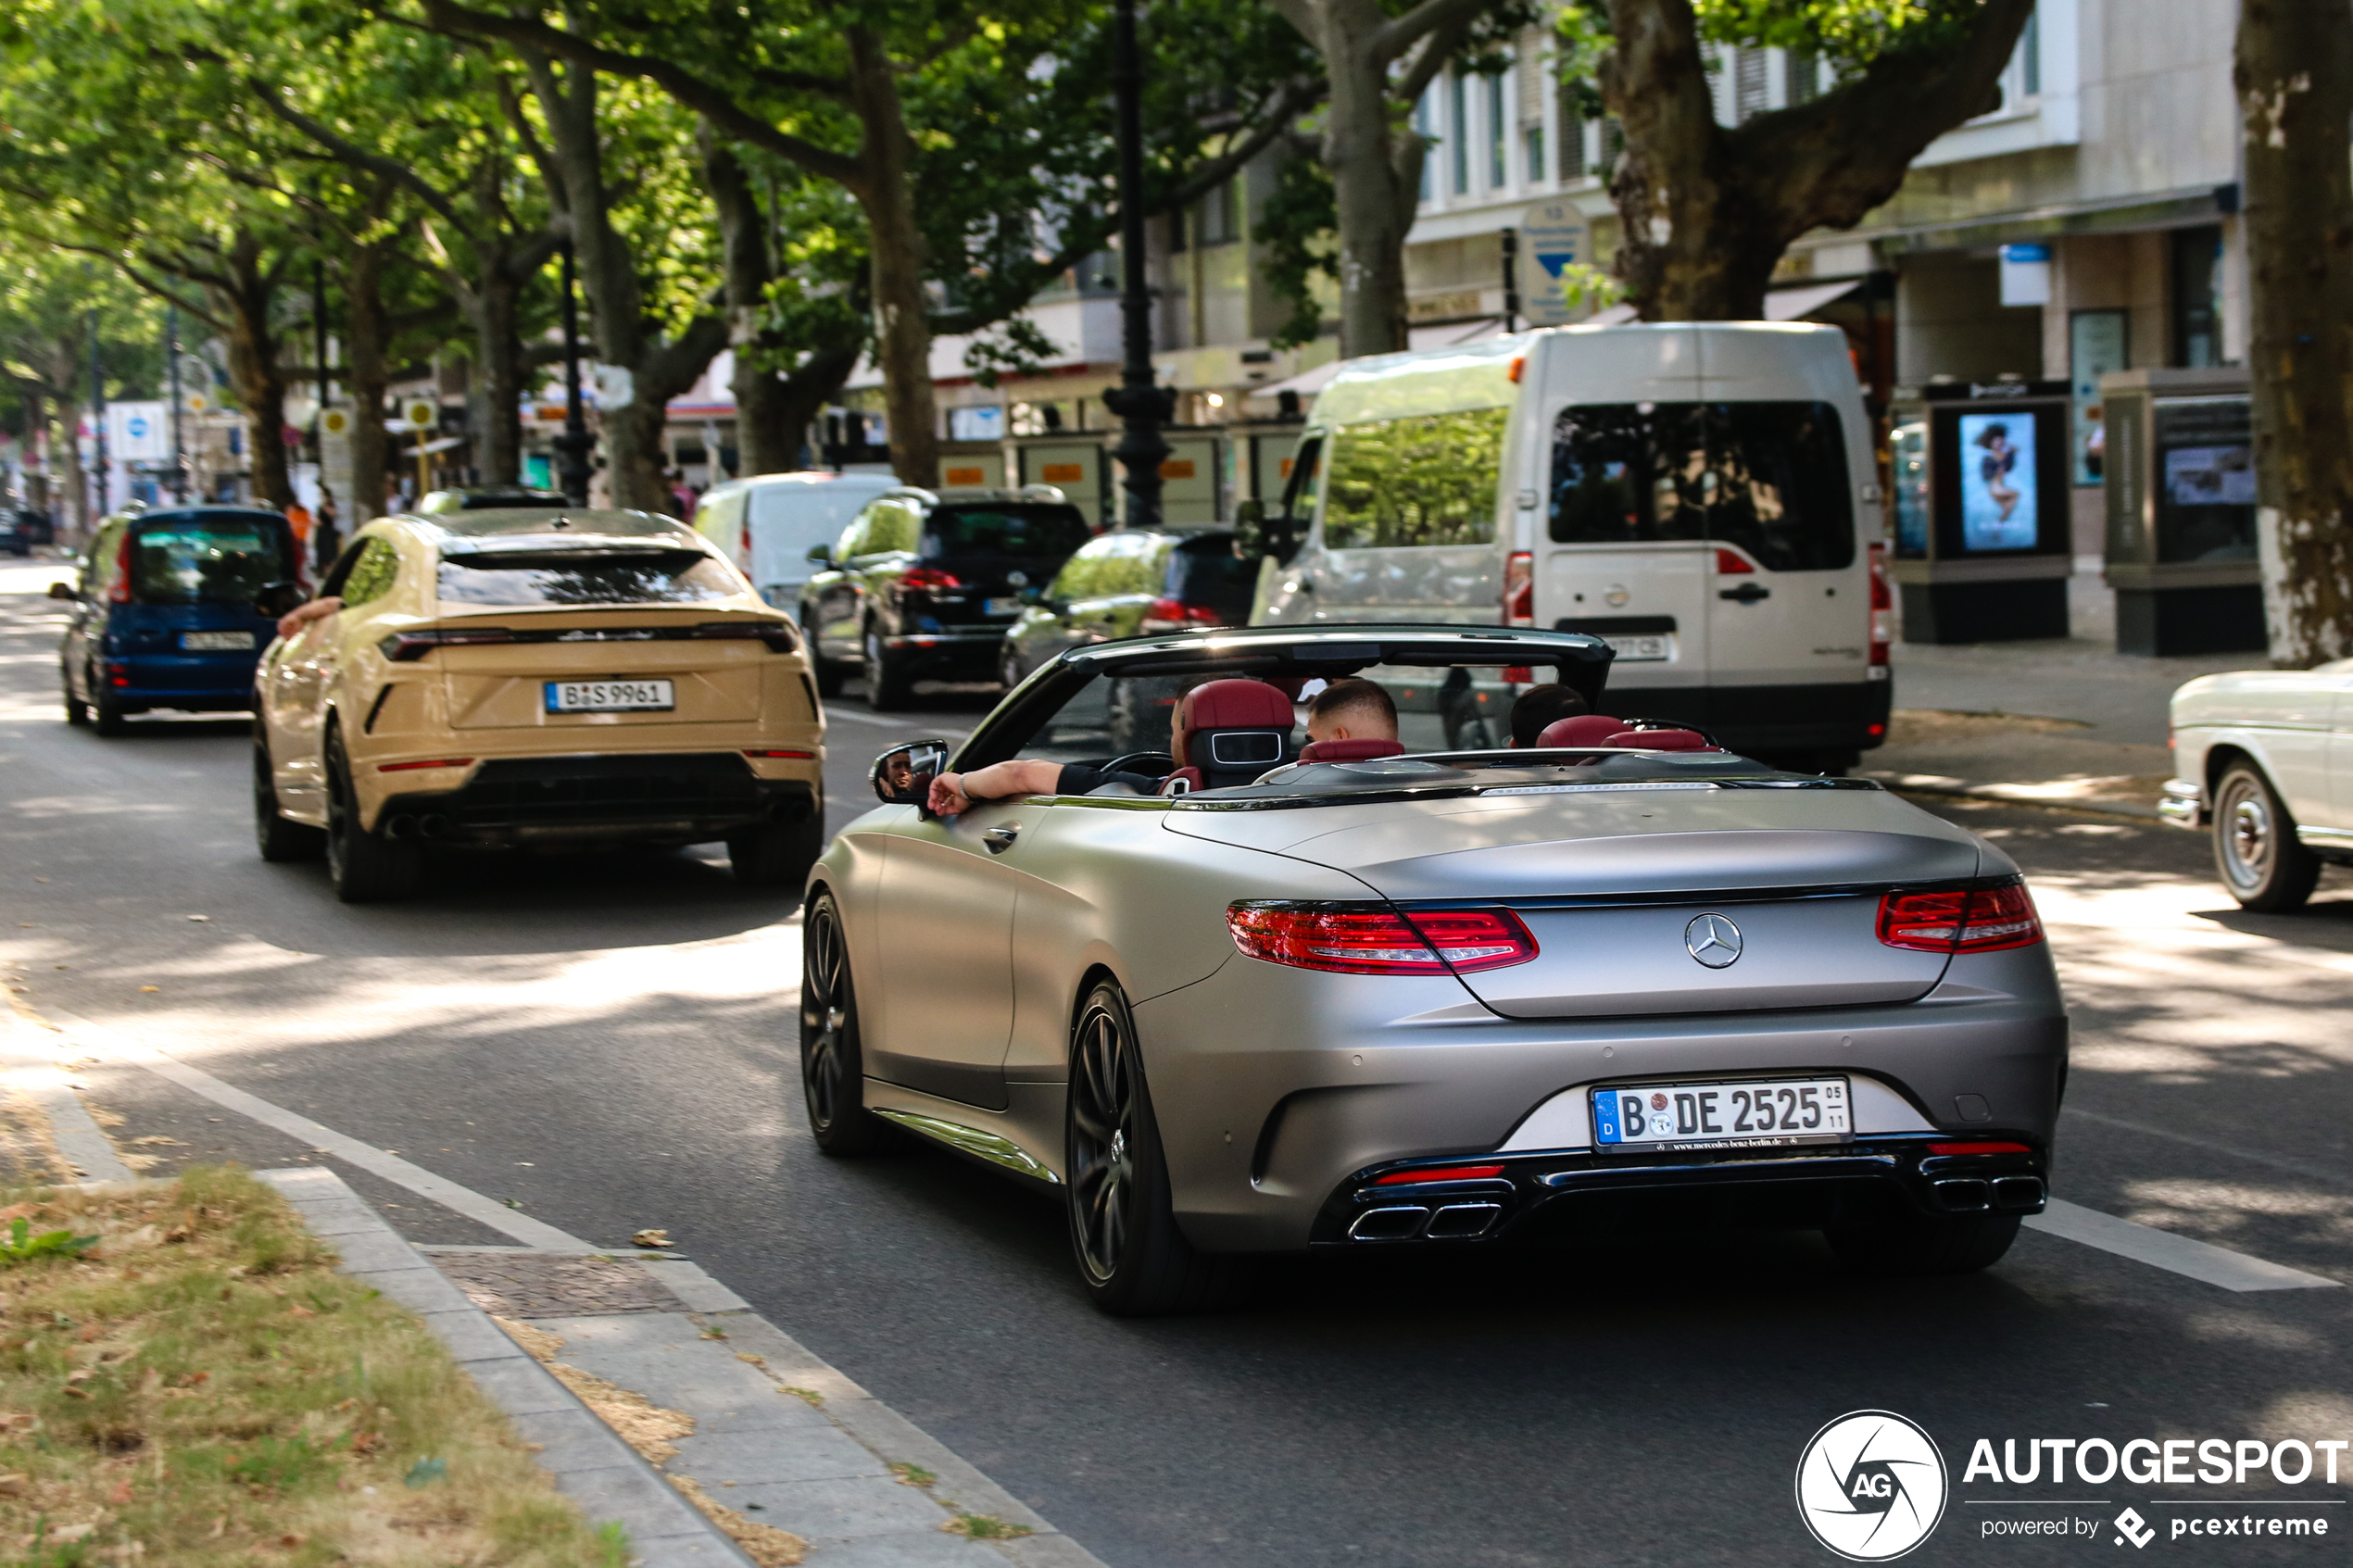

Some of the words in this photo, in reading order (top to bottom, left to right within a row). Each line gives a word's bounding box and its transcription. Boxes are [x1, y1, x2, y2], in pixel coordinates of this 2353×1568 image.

[565, 686, 579, 705] B
[593, 685, 607, 704] S
[610, 684, 661, 704] 9961
[1826, 1086, 1842, 1099] 05
[1622, 1096, 1646, 1136] B
[1674, 1091, 1723, 1134] DE
[1731, 1087, 1821, 1132] 2525
[1829, 1115, 1843, 1128] 11
[1603, 1123, 1614, 1135] D
